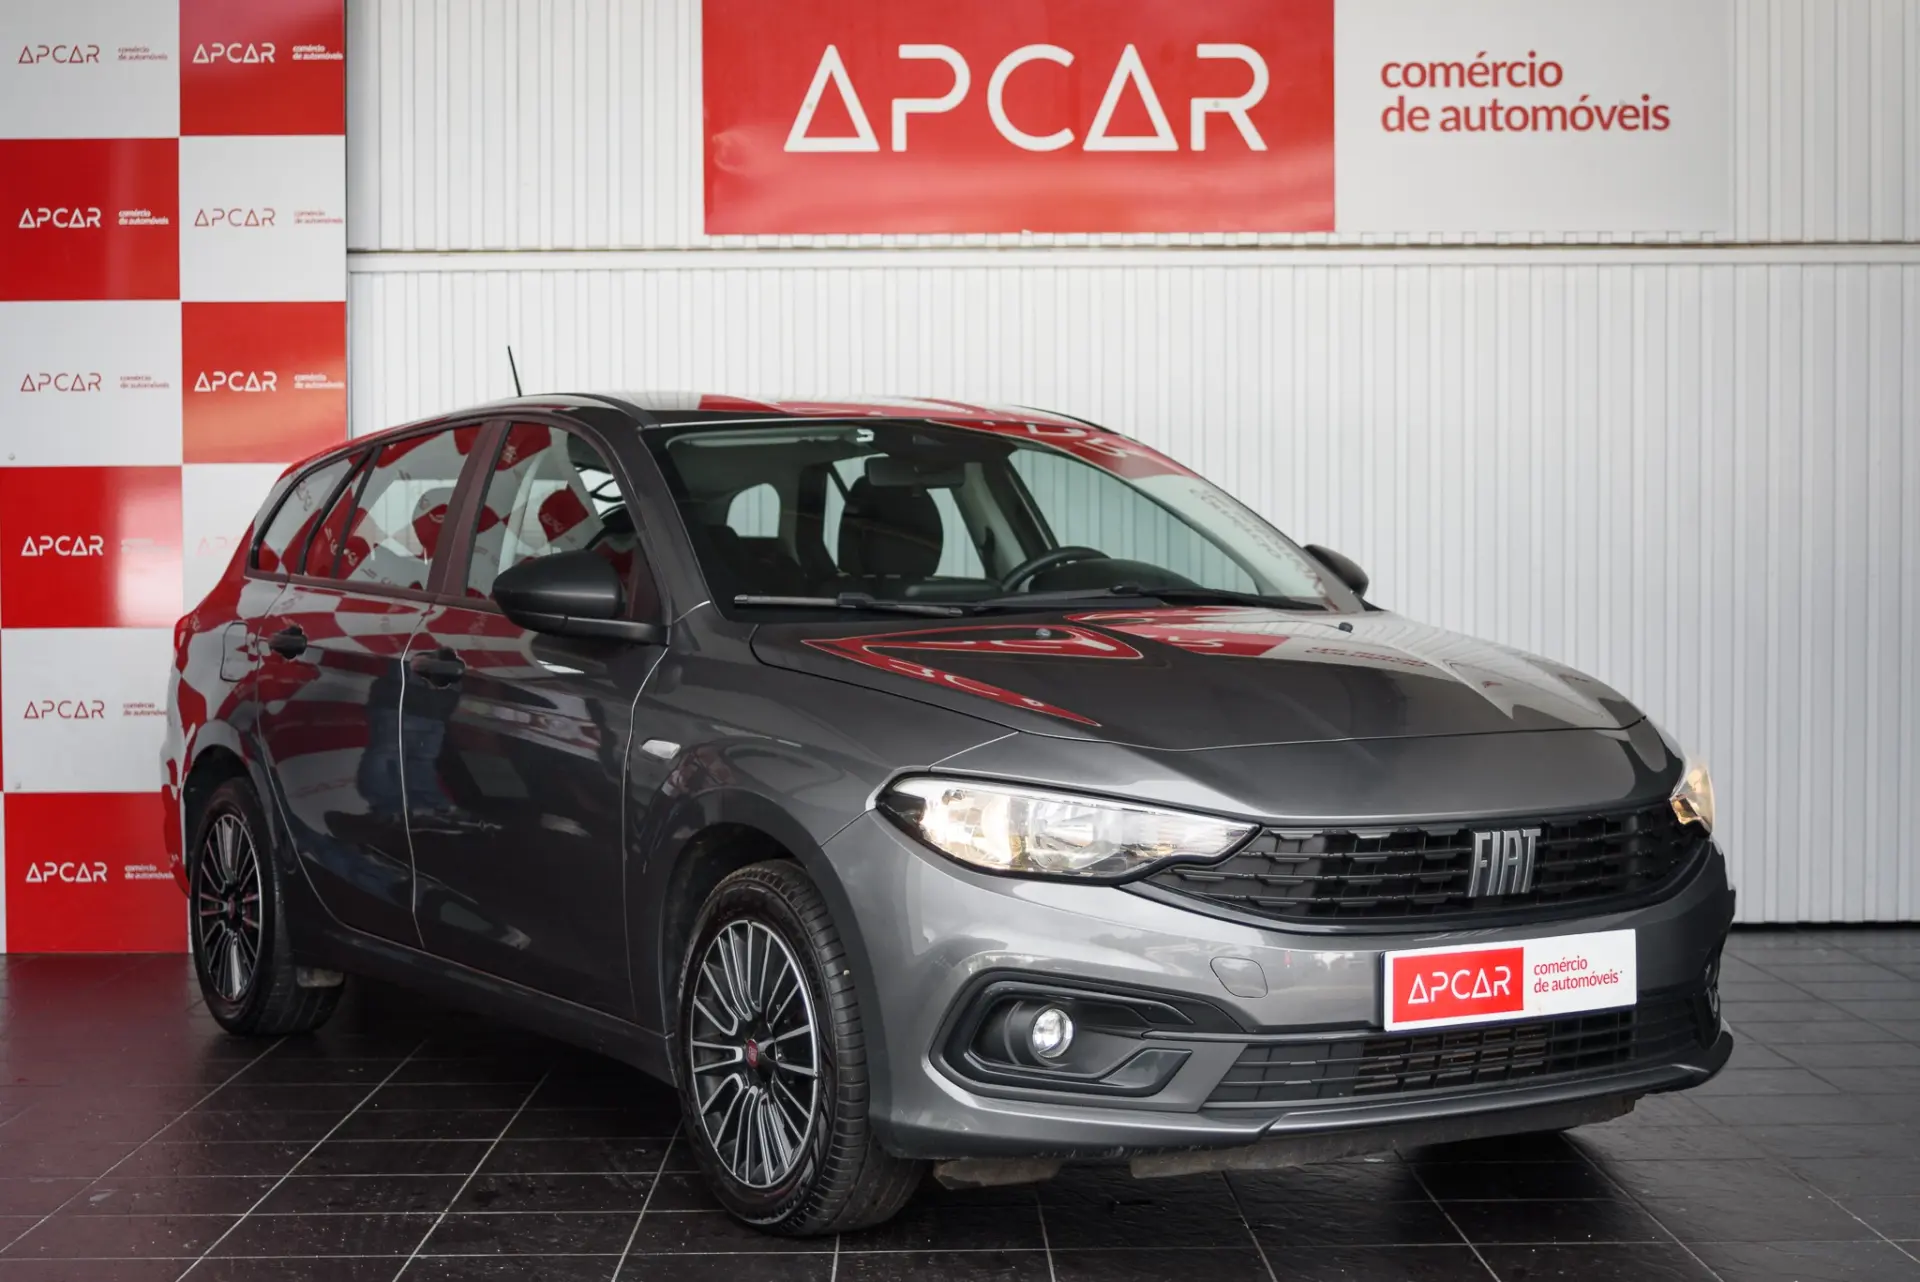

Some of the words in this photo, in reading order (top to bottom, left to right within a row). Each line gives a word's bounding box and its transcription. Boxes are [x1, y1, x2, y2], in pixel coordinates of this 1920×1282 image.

[18, 44, 100, 64] APCAR
[192, 42, 276, 64] APCAR
[1380, 50, 1564, 89] comércio
[783, 43, 1270, 153] APCAR
[1380, 95, 1431, 133] de
[1439, 93, 1671, 133] automóveis
[18, 207, 102, 228] APCAR
[194, 207, 276, 228] APCAR
[20, 372, 102, 392] APCAR
[194, 370, 277, 392] APCAR
[21, 534, 104, 556] APCAR
[23, 699, 105, 719] APCAR
[26, 861, 108, 882] APCAR
[1467, 828, 1541, 898] FIAT
[1533, 954, 1588, 976] comércio
[1407, 965, 1512, 1005] APCAR
[1533, 977, 1549, 994] de
[1551, 968, 1619, 992] automóveis
